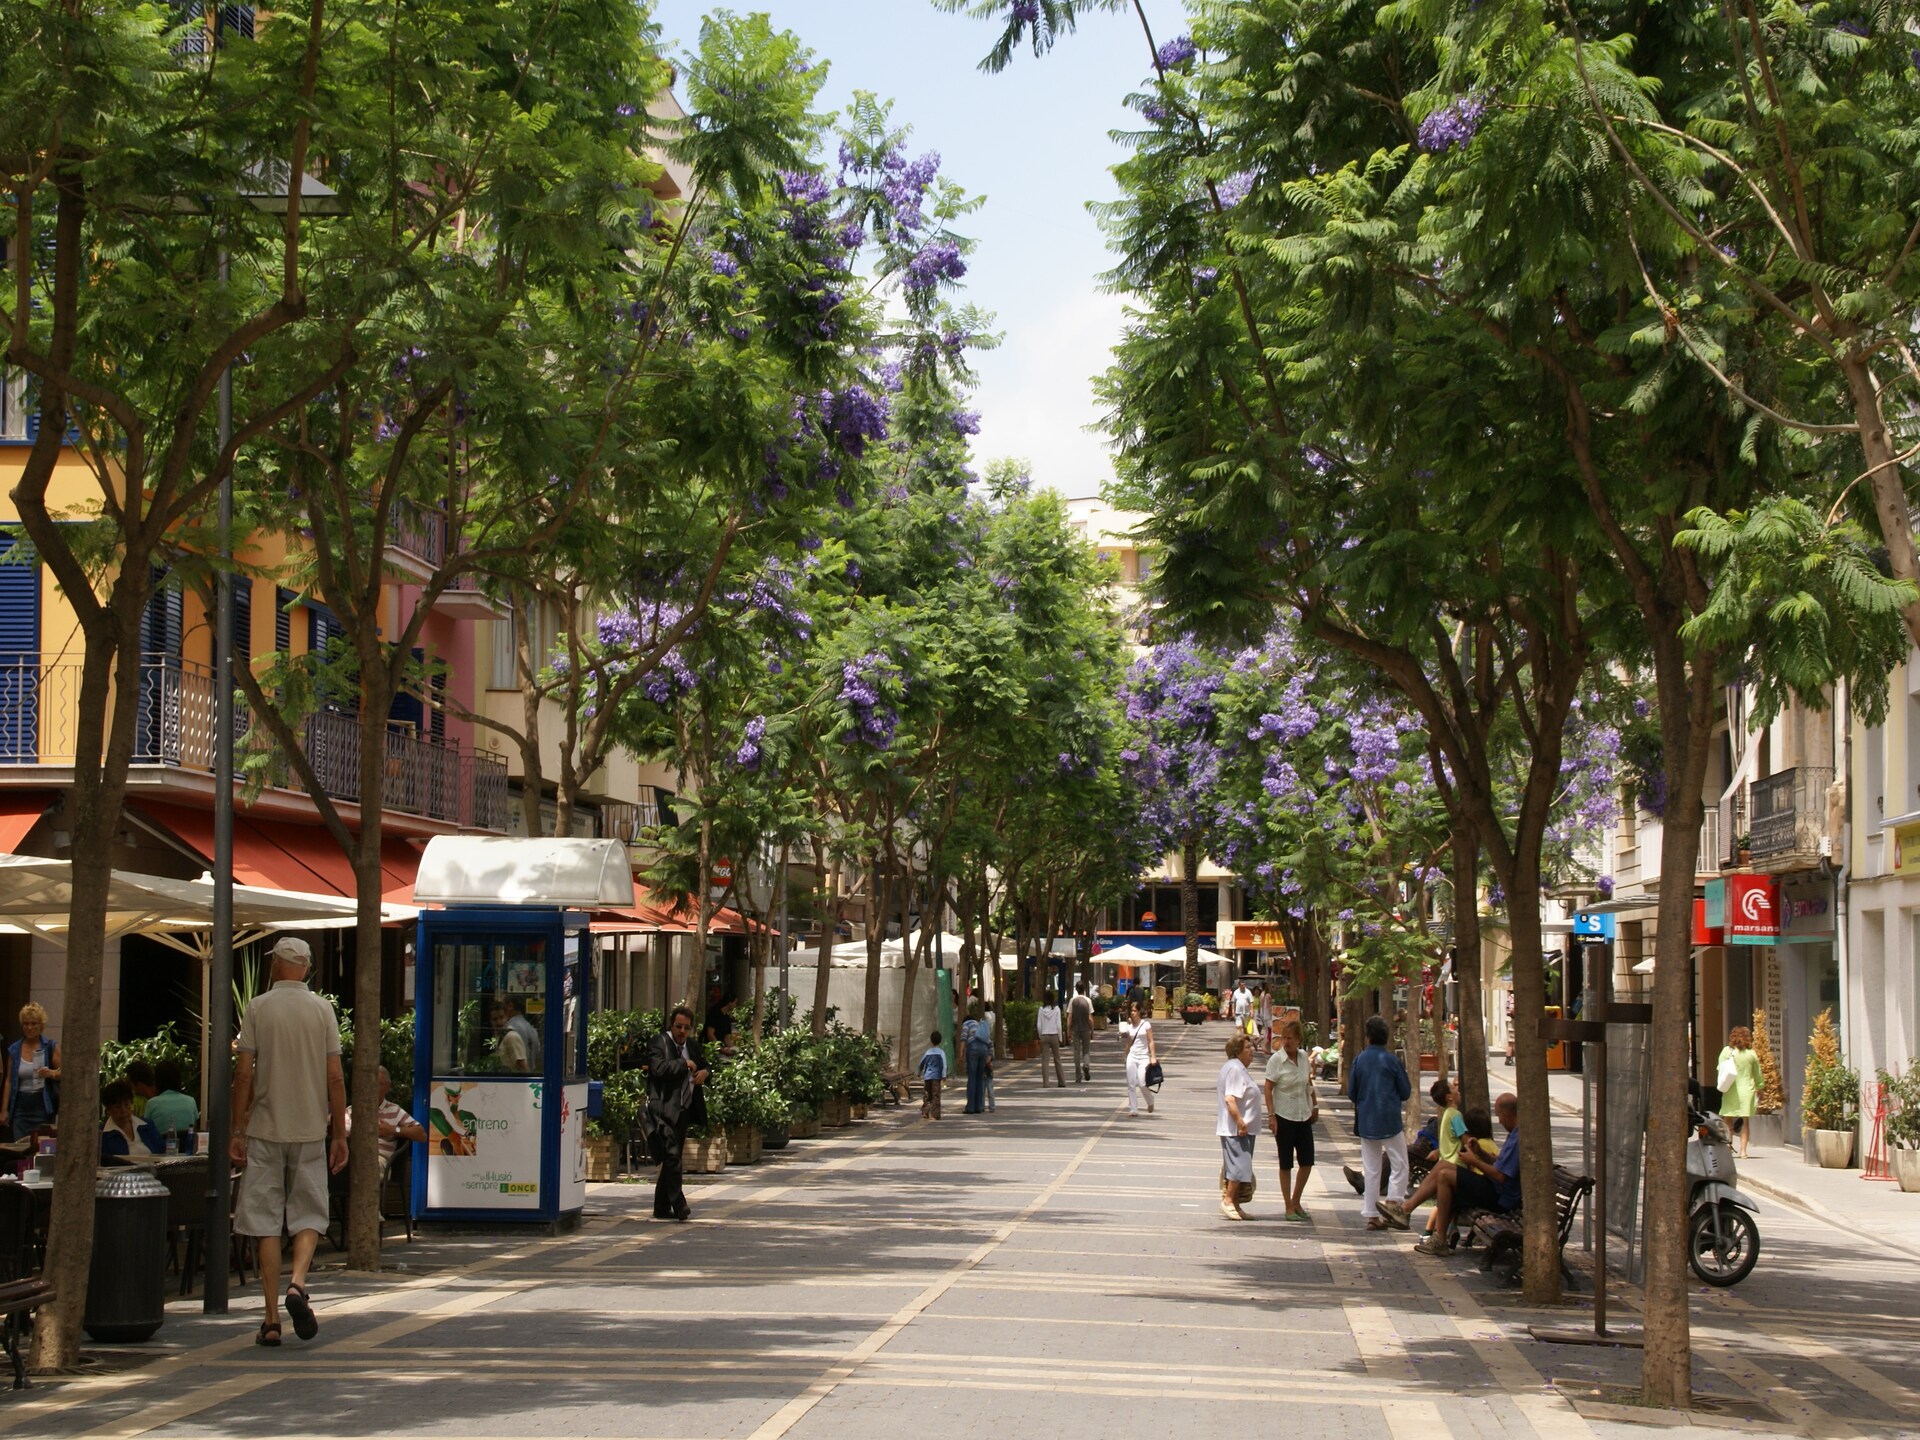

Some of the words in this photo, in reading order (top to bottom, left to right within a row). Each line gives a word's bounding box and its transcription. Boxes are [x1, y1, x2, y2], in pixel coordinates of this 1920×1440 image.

[1733, 925, 1780, 933] marsans
[463, 1118, 508, 1129] entreno
[465, 1181, 499, 1191] sempre
[510, 1184, 536, 1192] ONCE
